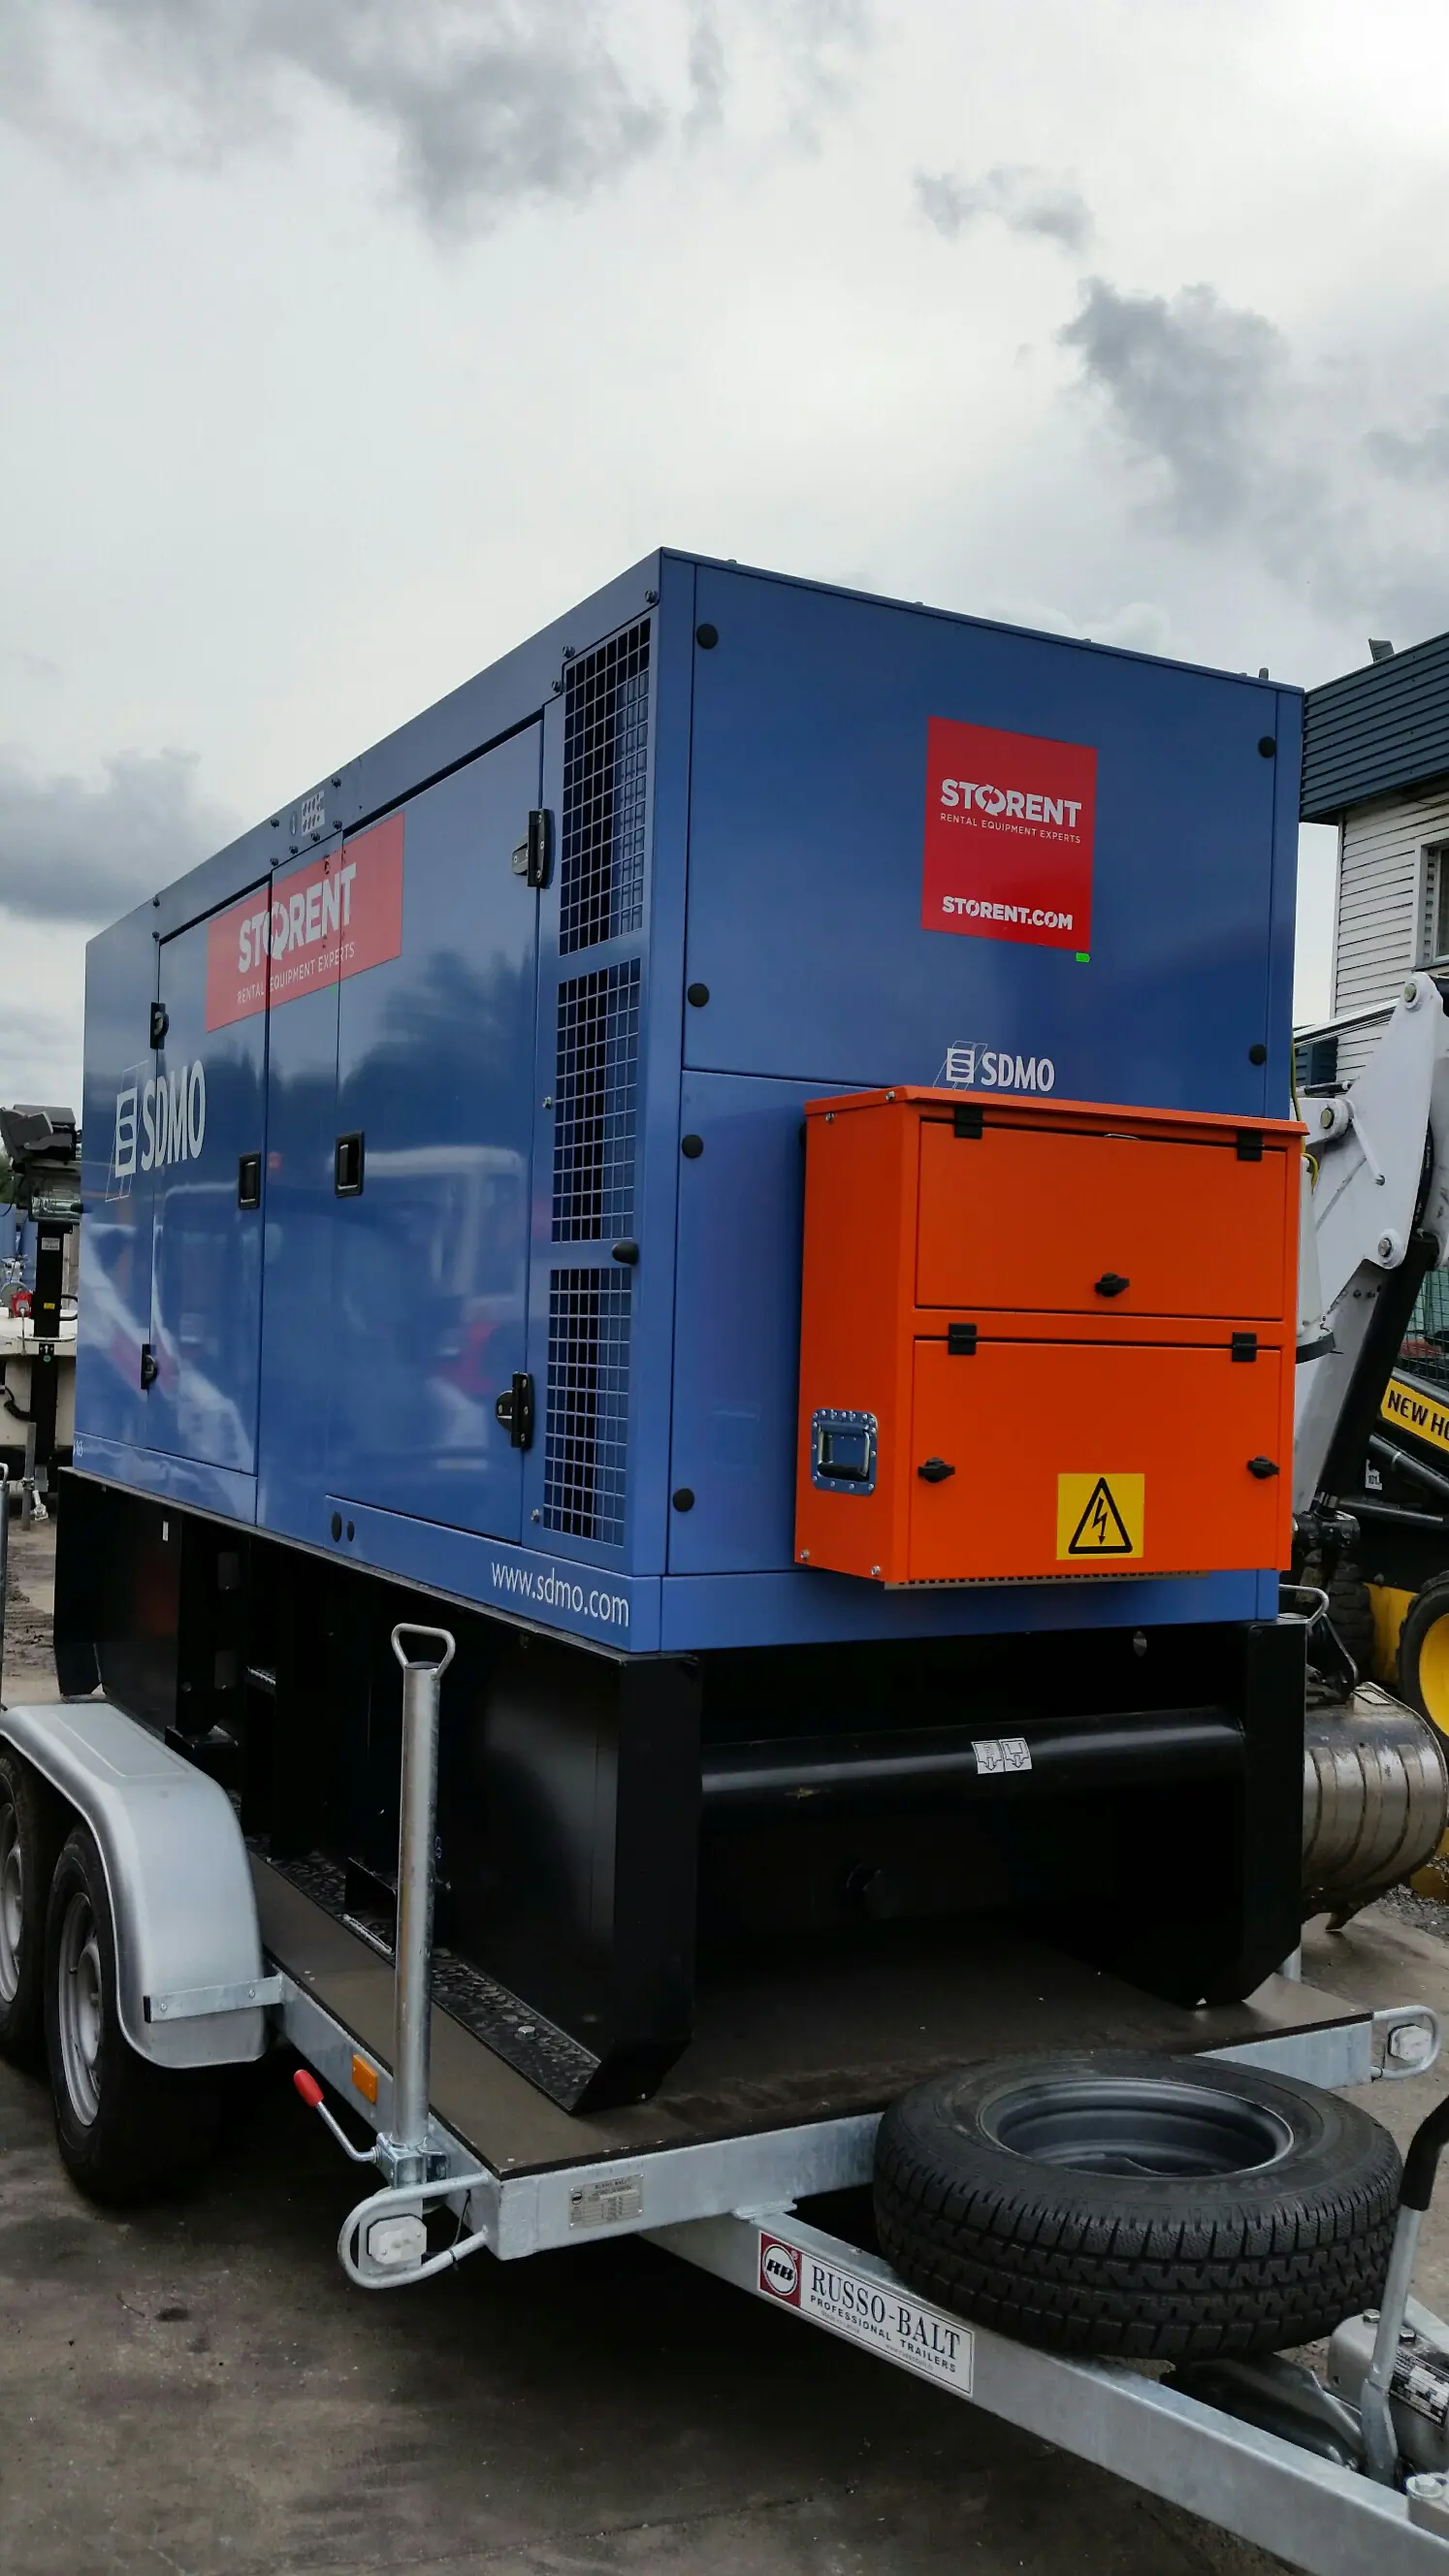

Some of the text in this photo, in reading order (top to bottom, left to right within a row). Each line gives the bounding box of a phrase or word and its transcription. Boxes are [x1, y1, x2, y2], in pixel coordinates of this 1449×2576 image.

[940, 813, 1081, 844] RENTAL EQUIPMENT EXPERTS
[941, 779, 1081, 827] STORENT
[238, 862, 357, 973] STORENT
[943, 895, 1073, 930] STORENT.COM
[237, 942, 355, 1005] RENTAL EQUIPMENT EXPERTS
[981, 1051, 1055, 1092] SDMO
[141, 1059, 206, 1171] SDMO
[1387, 1389, 1429, 1427] NEW
[491, 1562, 629, 1627] www.sdmo.com
[810, 2295, 892, 2342] PROFESSIONAL
[900, 2338, 957, 2373] TRAILERS
[811, 2265, 961, 2361] RUSSO-BALT
